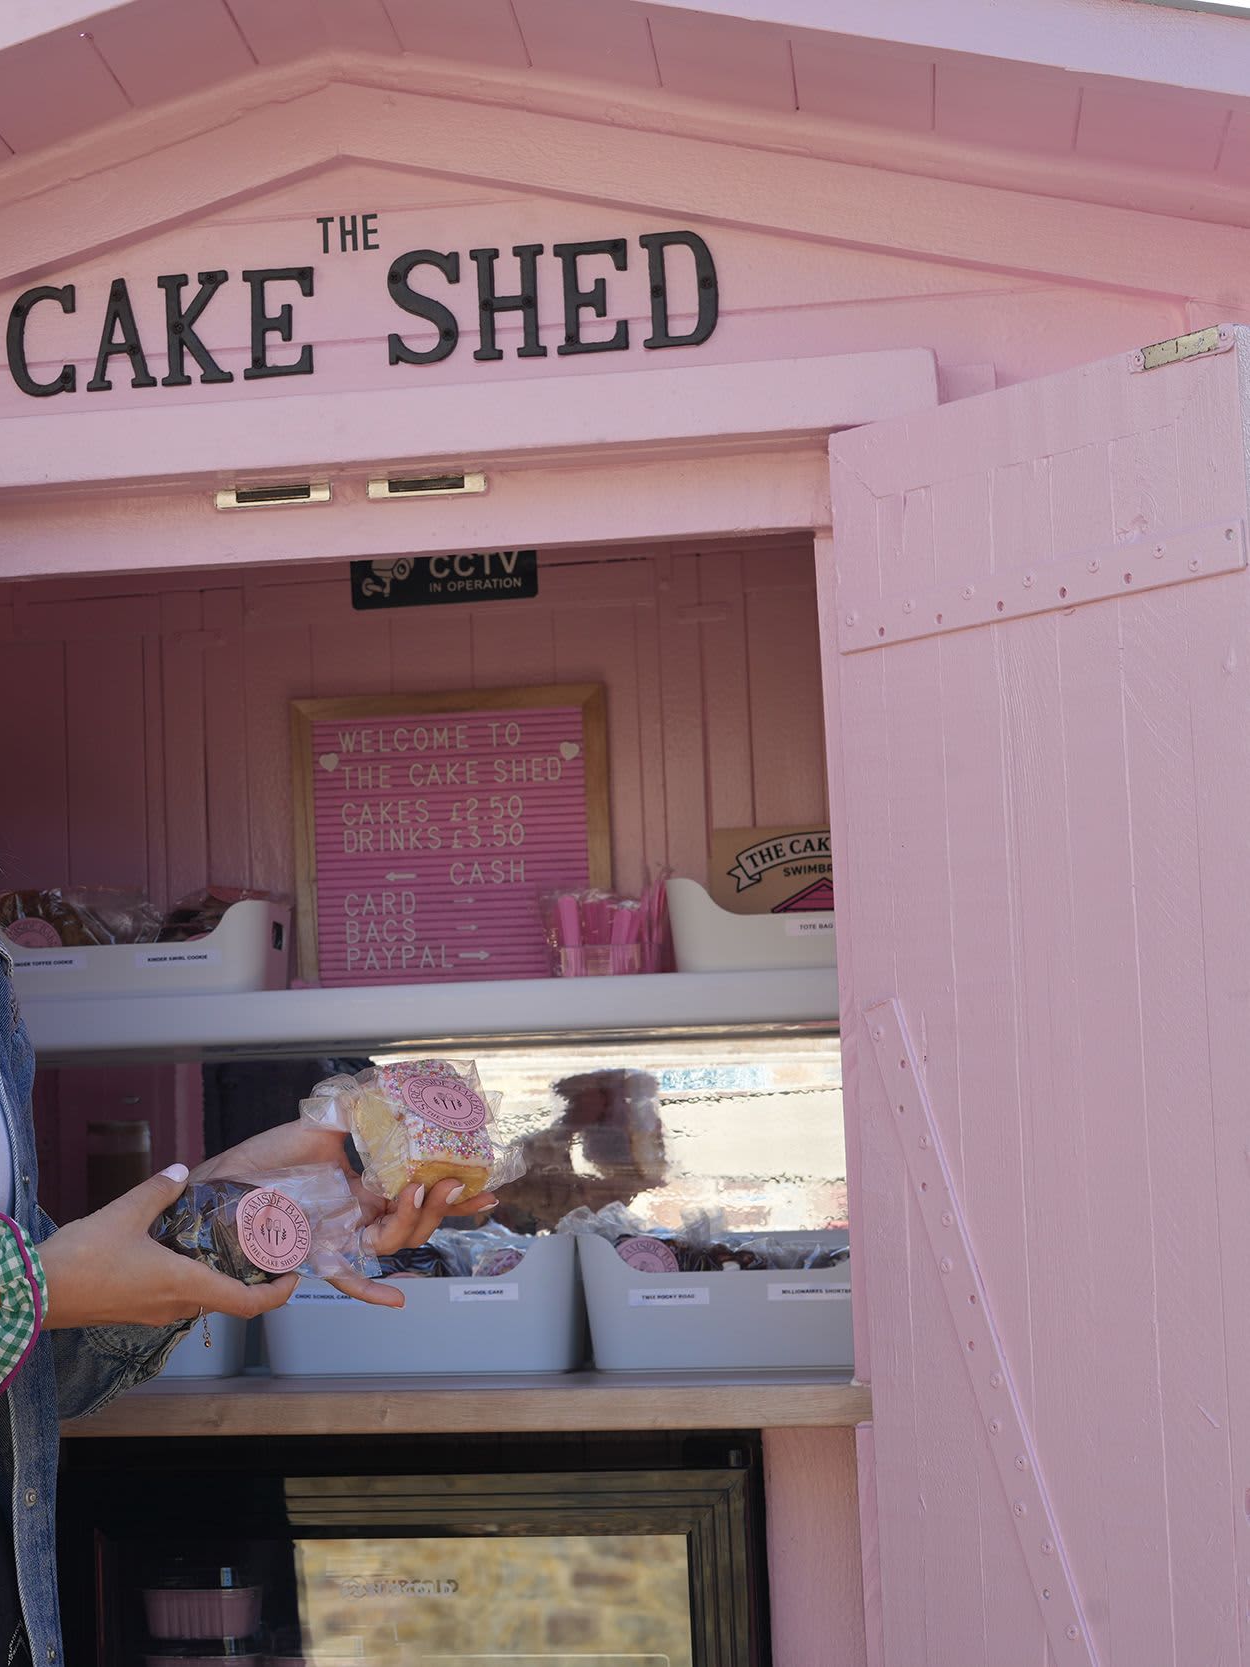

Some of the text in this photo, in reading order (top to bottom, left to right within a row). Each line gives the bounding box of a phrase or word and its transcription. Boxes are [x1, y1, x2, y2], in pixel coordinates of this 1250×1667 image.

[317, 214, 380, 254] THE
[6, 230, 719, 398] CAKE SHED
[429, 551, 519, 578] CCTV
[429, 577, 522, 593] IN OPERATION
[339, 722, 520, 753] WELCOME TO
[341, 756, 562, 790] THE CAKE SHED
[341, 795, 524, 826] CAKES £2.50
[343, 822, 525, 853] DRINKS £3.50
[745, 843, 786, 869] THE
[449, 859, 526, 886] CASH
[344, 891, 417, 917] CARD
[345, 918, 417, 945] BACS
[346, 944, 454, 971] PAYPAL
[442, 1118, 462, 1127] CAKE
[244, 1193, 308, 1254] STREAMSIDE BAKERY
[250, 1243, 298, 1267] THE CAKE SHED
